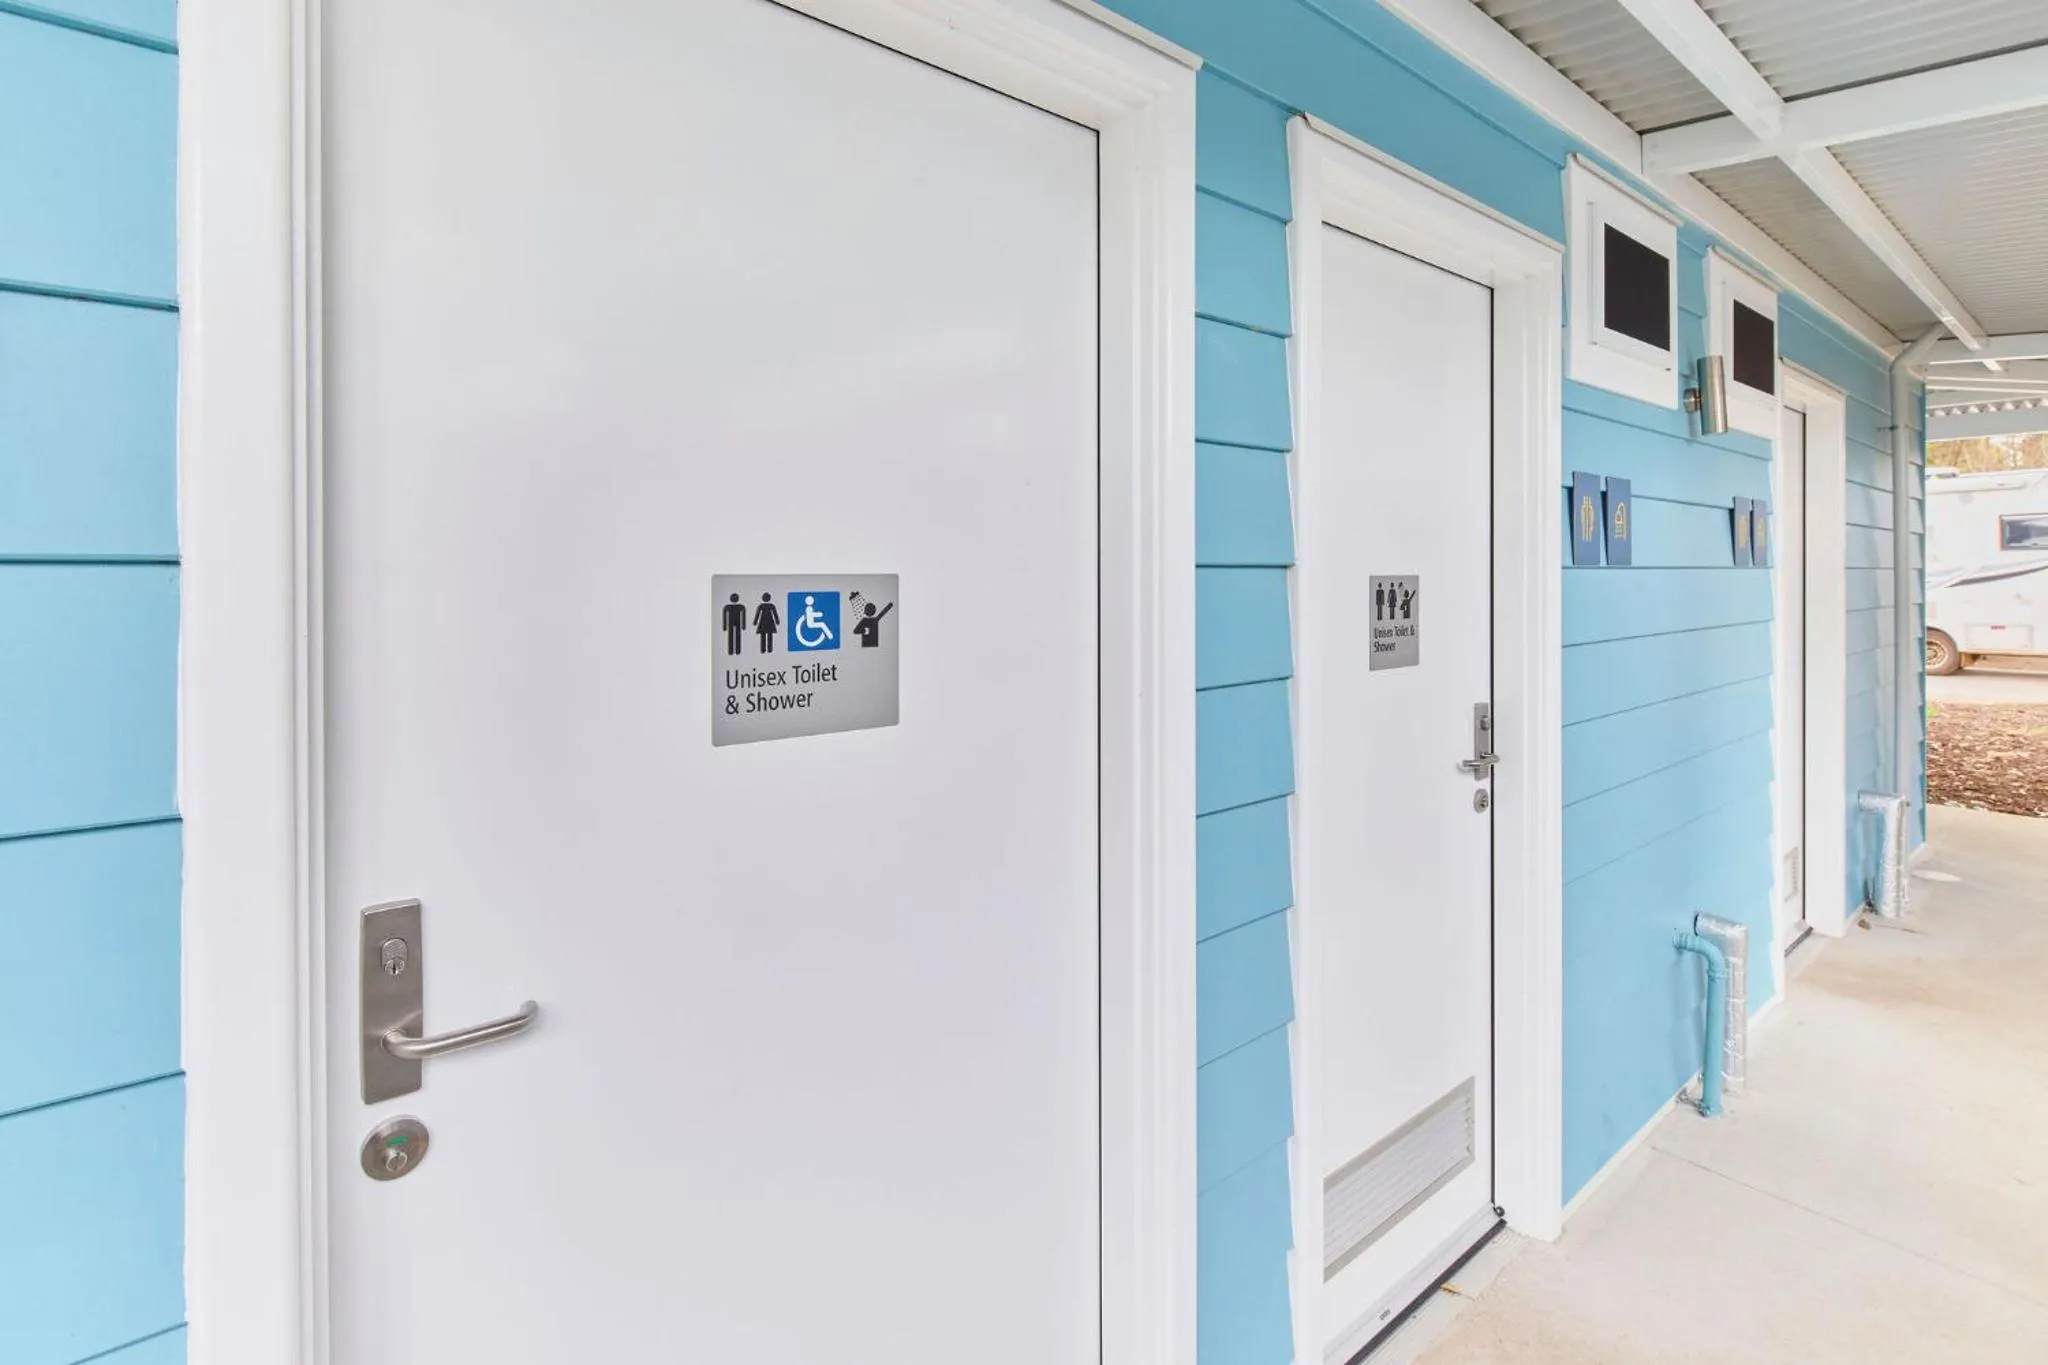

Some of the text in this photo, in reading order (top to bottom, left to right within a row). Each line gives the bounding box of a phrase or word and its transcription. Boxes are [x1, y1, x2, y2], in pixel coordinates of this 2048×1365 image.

[726, 663, 837, 689] Unisex Toilet
[725, 691, 813, 714] & Shower
